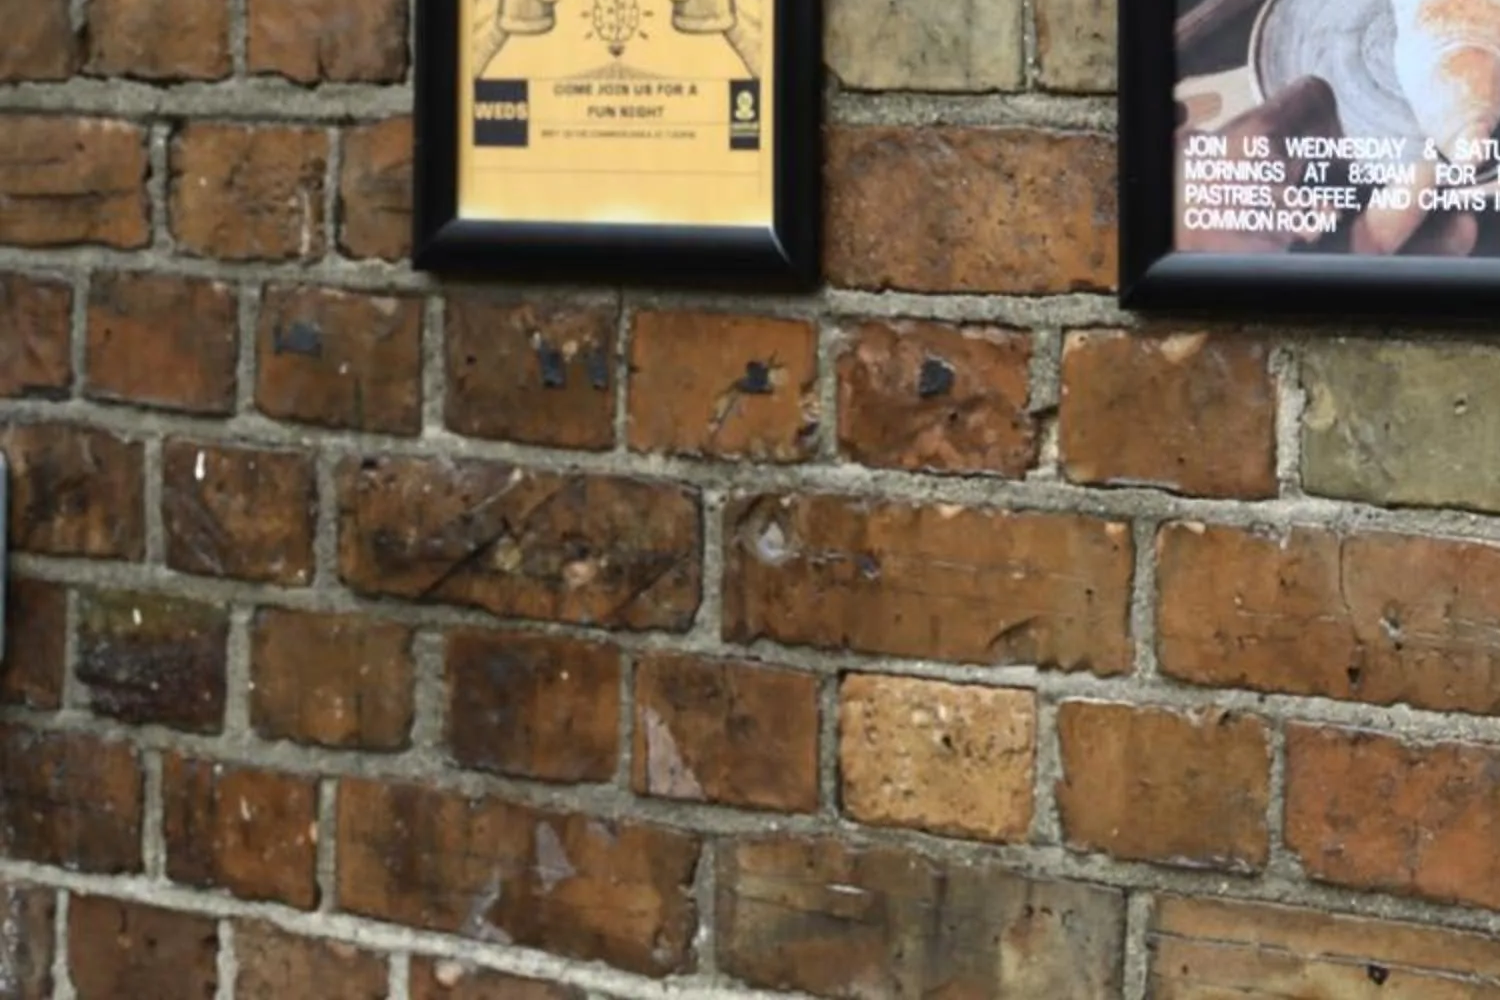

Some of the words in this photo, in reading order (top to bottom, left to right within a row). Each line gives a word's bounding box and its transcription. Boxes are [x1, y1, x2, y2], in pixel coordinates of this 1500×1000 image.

[474, 101, 529, 121] WEDS
[1184, 135, 1227, 156] JOIN
[1243, 136, 1270, 157] US
[1285, 136, 1406, 159] WEDNESDAY
[1423, 137, 1437, 160] &
[1184, 160, 1285, 182] MORNINGS
[1303, 161, 1330, 183] AT
[1348, 162, 1415, 185] 8:30AM
[1436, 163, 1477, 185] FOR
[1184, 184, 1276, 209] PASTRIES,
[1283, 186, 1362, 211] COFFEE,
[1367, 188, 1411, 210] AND
[1417, 188, 1486, 212] CHATS
[1184, 208, 1274, 231] COMMON
[1276, 210, 1337, 233] ROOM
